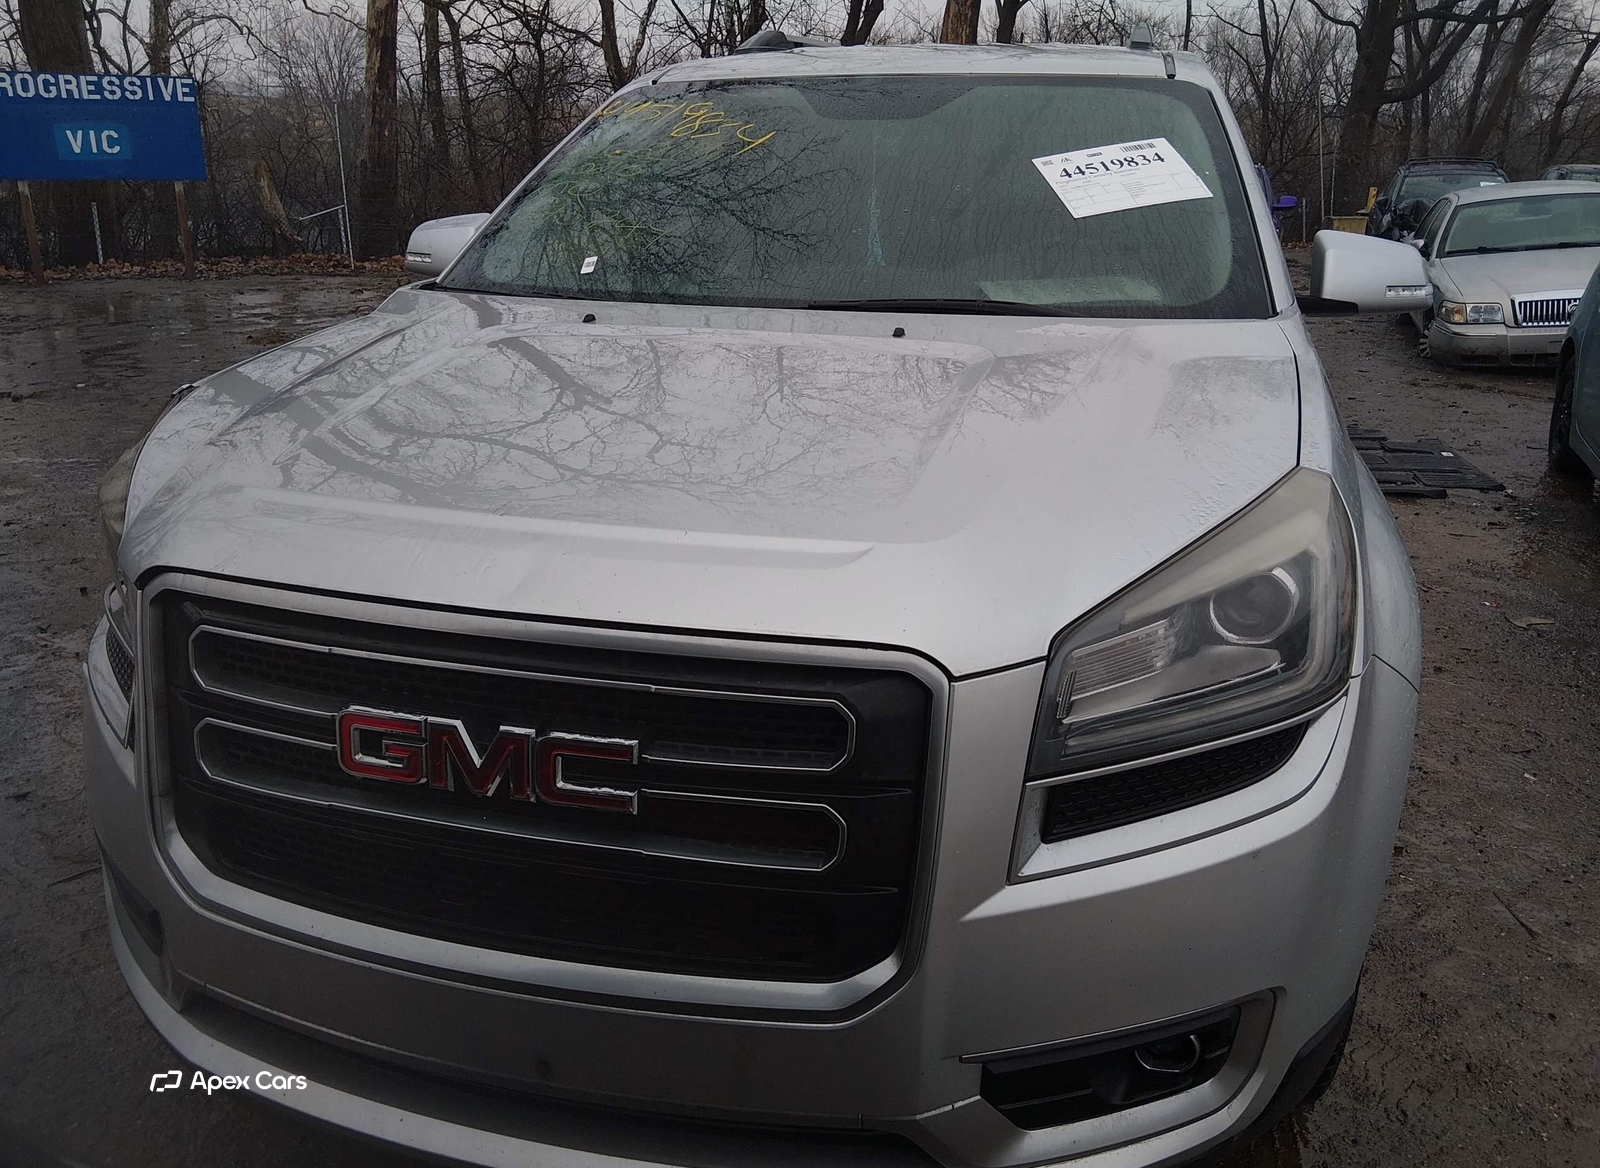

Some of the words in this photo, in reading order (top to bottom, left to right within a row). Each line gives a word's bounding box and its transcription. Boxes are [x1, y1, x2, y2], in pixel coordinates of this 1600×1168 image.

[0, 73, 195, 102] ROGRESSIVE
[66, 130, 120, 154] VIC
[1059, 152, 1165, 179] 44519834
[336, 704, 639, 815] GMC
